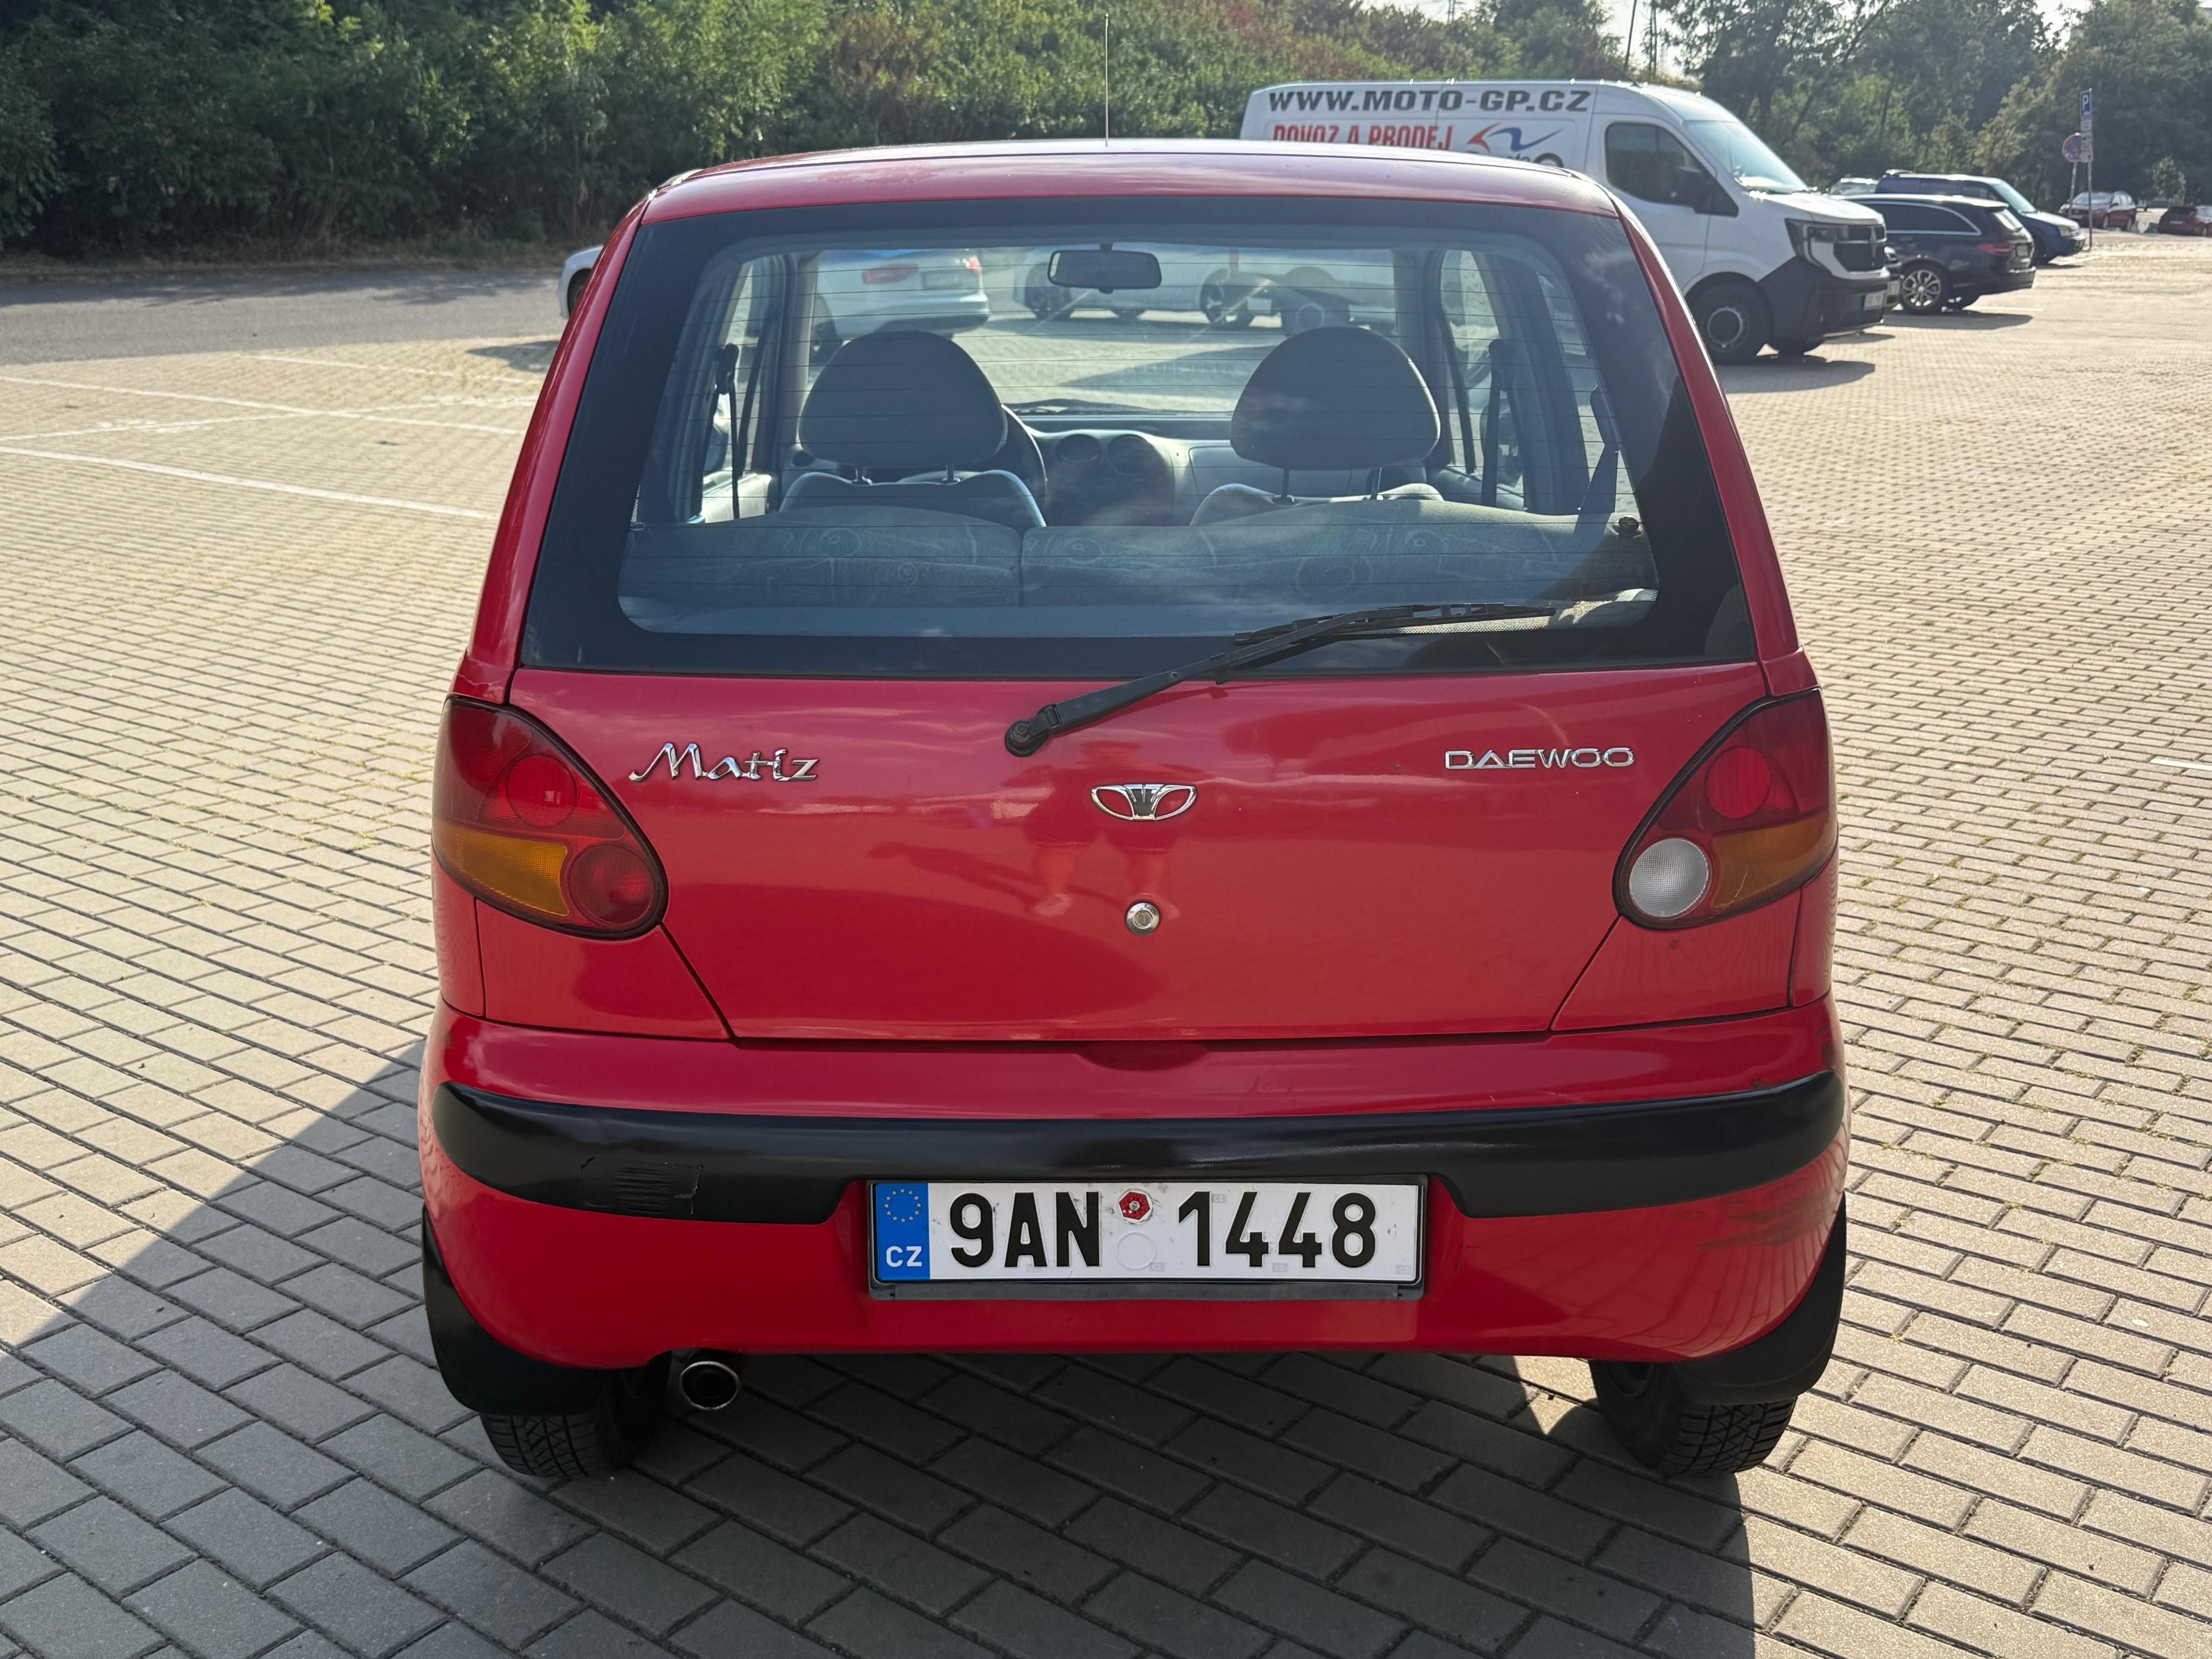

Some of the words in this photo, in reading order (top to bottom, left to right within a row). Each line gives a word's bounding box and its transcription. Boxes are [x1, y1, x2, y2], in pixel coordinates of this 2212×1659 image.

[1269, 90, 1591, 112] WWW.MOTO-GP.CZ
[2082, 94, 2089, 111] P
[1347, 125, 1360, 144] A
[1368, 125, 1453, 150] PRODEJ
[629, 743, 820, 781] Matiz
[1445, 747, 1635, 769] DAEWOO
[949, 1191, 1101, 1268] 9AN
[1178, 1191, 1376, 1268] 1448
[886, 1246, 922, 1267] CZ
